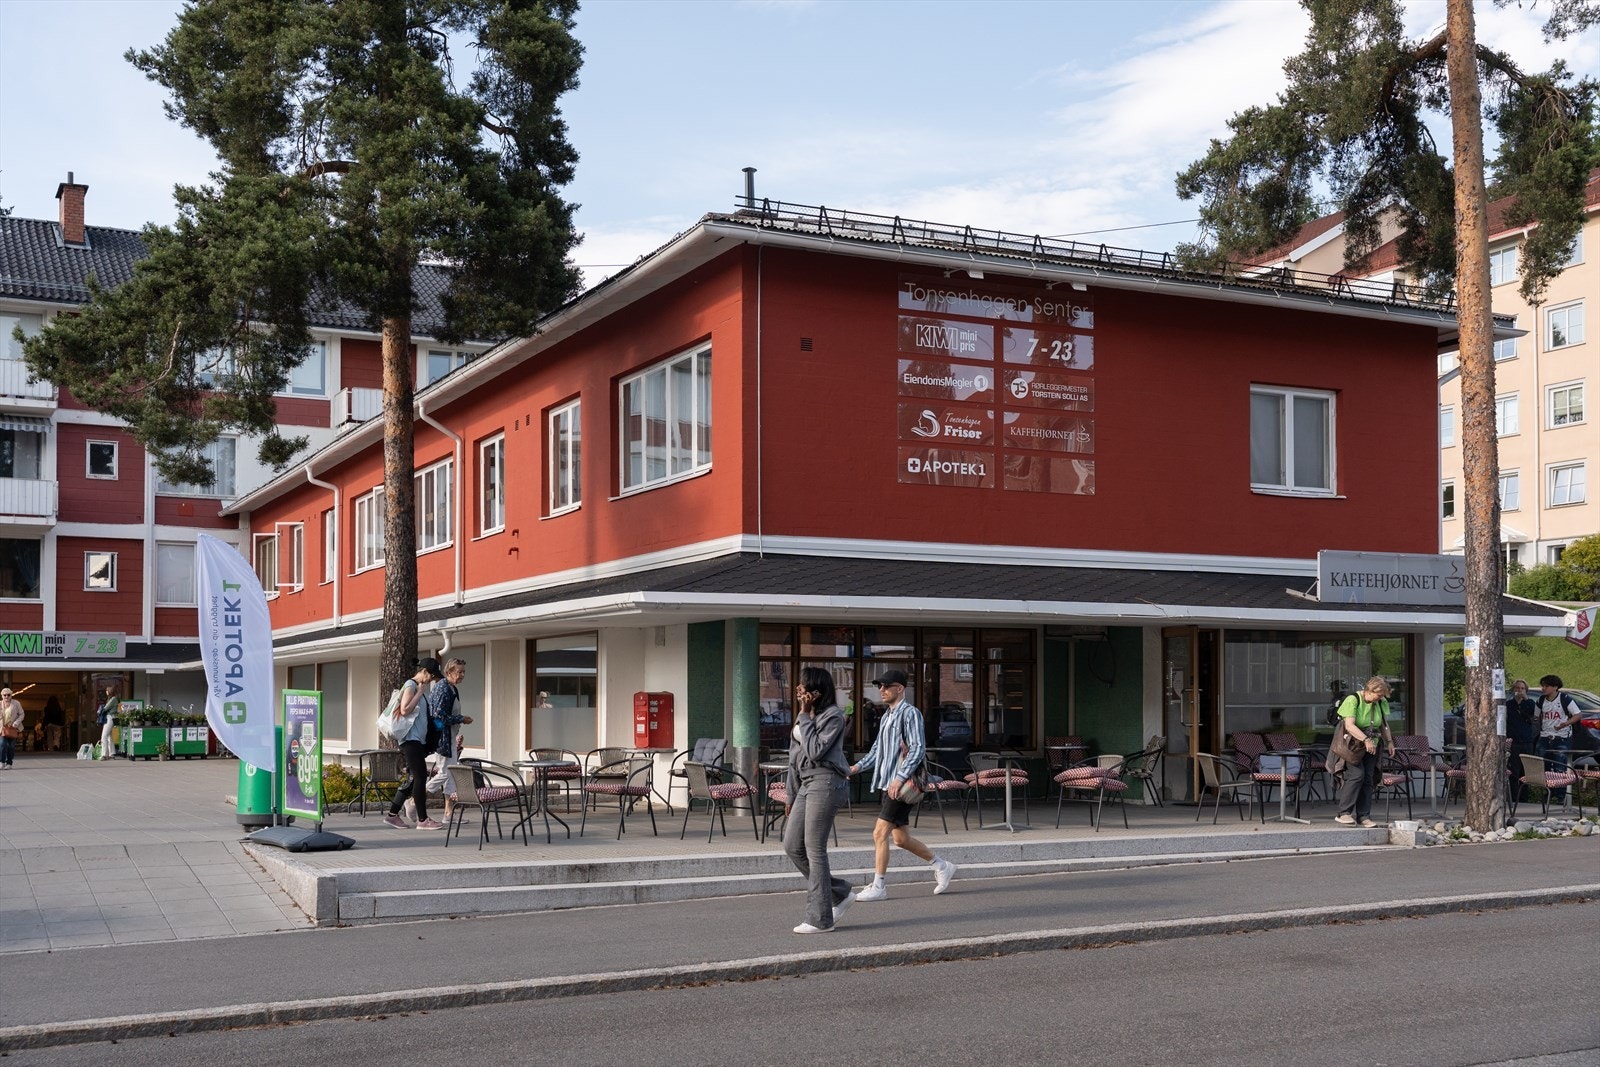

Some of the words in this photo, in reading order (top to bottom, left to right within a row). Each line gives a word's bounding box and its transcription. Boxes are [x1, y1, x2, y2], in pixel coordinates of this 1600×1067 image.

[904, 282, 1028, 314] Tonsenhagen
[1033, 297, 1089, 318] Senter
[916, 324, 958, 350] KIWI
[960, 330, 978, 341] mini
[960, 341, 976, 352] pris
[904, 373, 973, 389] EiendomsMegler
[1032, 390, 1061, 399] TORSTEIN
[944, 425, 982, 439] Frisør
[1010, 426, 1075, 440] KAFFEHJØRNET
[922, 461, 977, 475] APOTEK
[978, 464, 986, 476] 1
[1330, 572, 1439, 592] KAFFEHJØRNET
[45, 635, 65, 644] mini
[45, 644, 63, 656] pris
